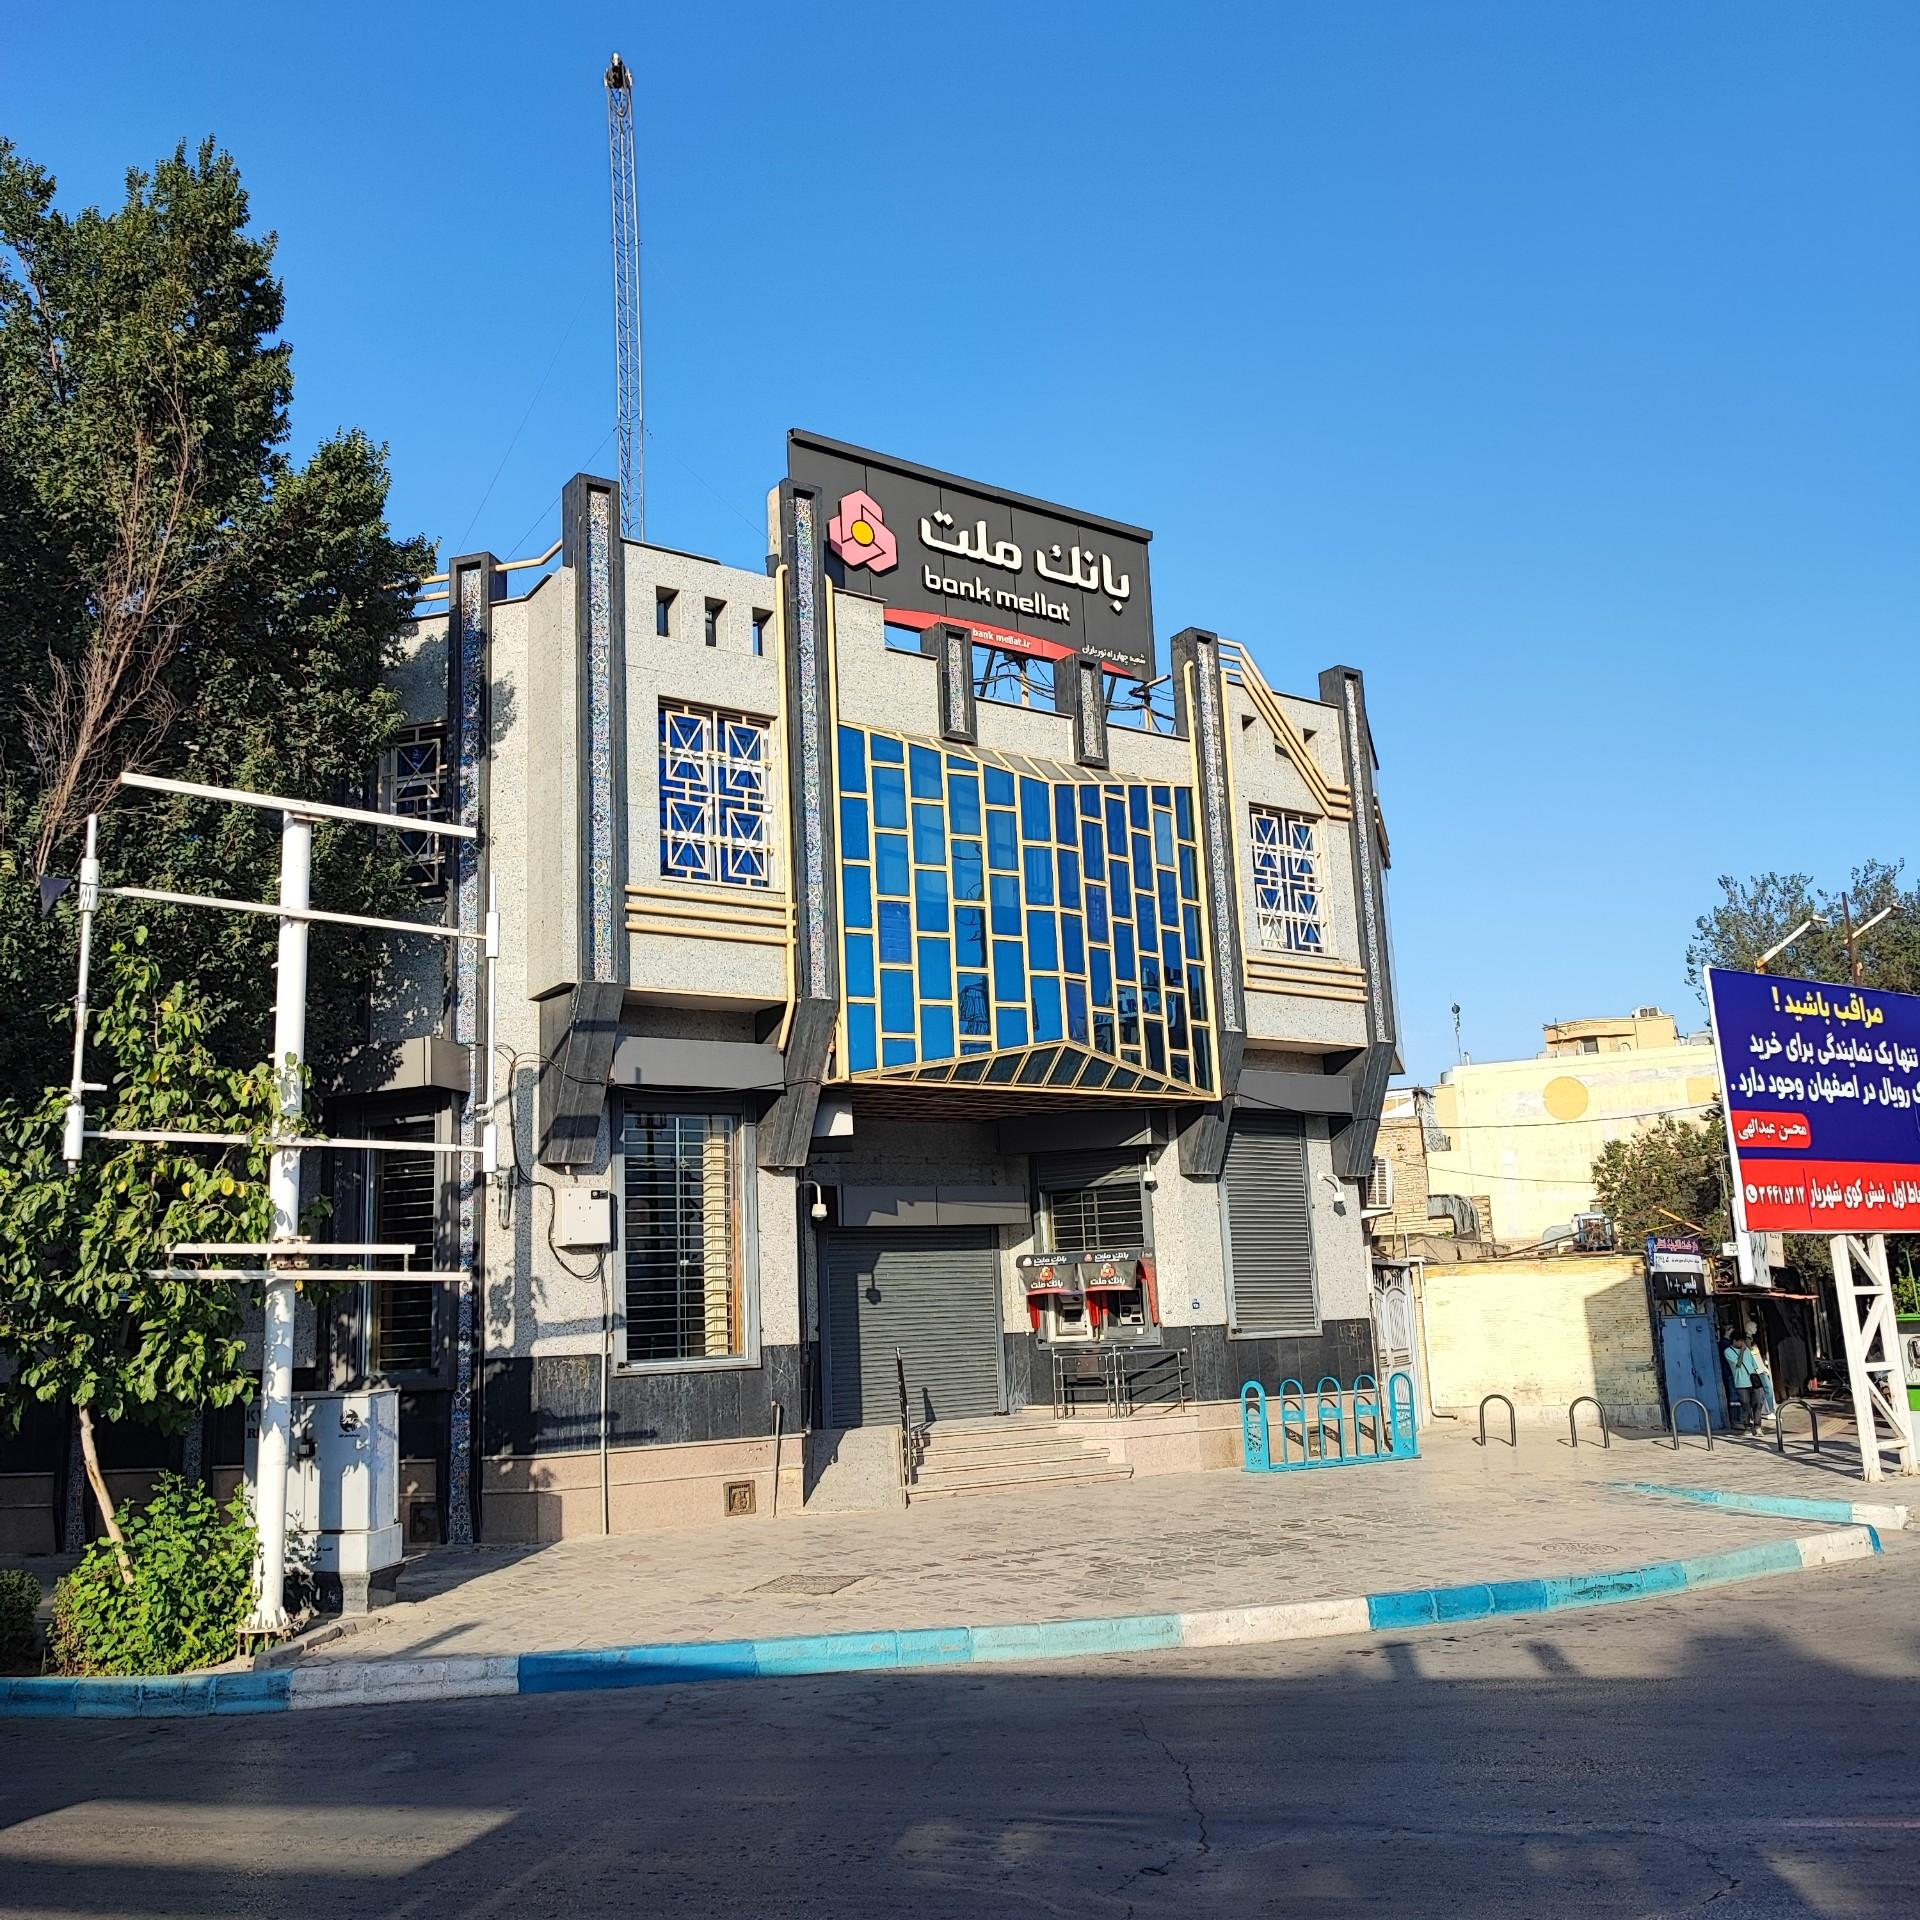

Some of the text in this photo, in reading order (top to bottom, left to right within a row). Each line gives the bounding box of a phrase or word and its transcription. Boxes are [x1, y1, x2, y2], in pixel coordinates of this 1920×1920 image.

[921, 510, 1022, 570] ملت
[925, 564, 1070, 621] bank mellat
[972, 628, 994, 641] bank
[1833, 993, 1884, 1028] مراقب
[1750, 1031, 1919, 1074] تنها یک نمایندگی برای خرید
[1768, 1073, 1804, 1100] وجود
[1808, 1071, 1860, 1103] اصفهان
[1863, 1082, 1877, 1105] در
[1879, 1077, 1911, 1109] رویال
[1778, 1123, 1808, 1141] محسن
[1811, 1178, 1843, 1208] شهریار
[1844, 1178, 1863, 1208] کوی
[1865, 1180, 1886, 1209] نبش
[1031, 1280, 1046, 1289] ملت
[1090, 1277, 1107, 1286] ملت
